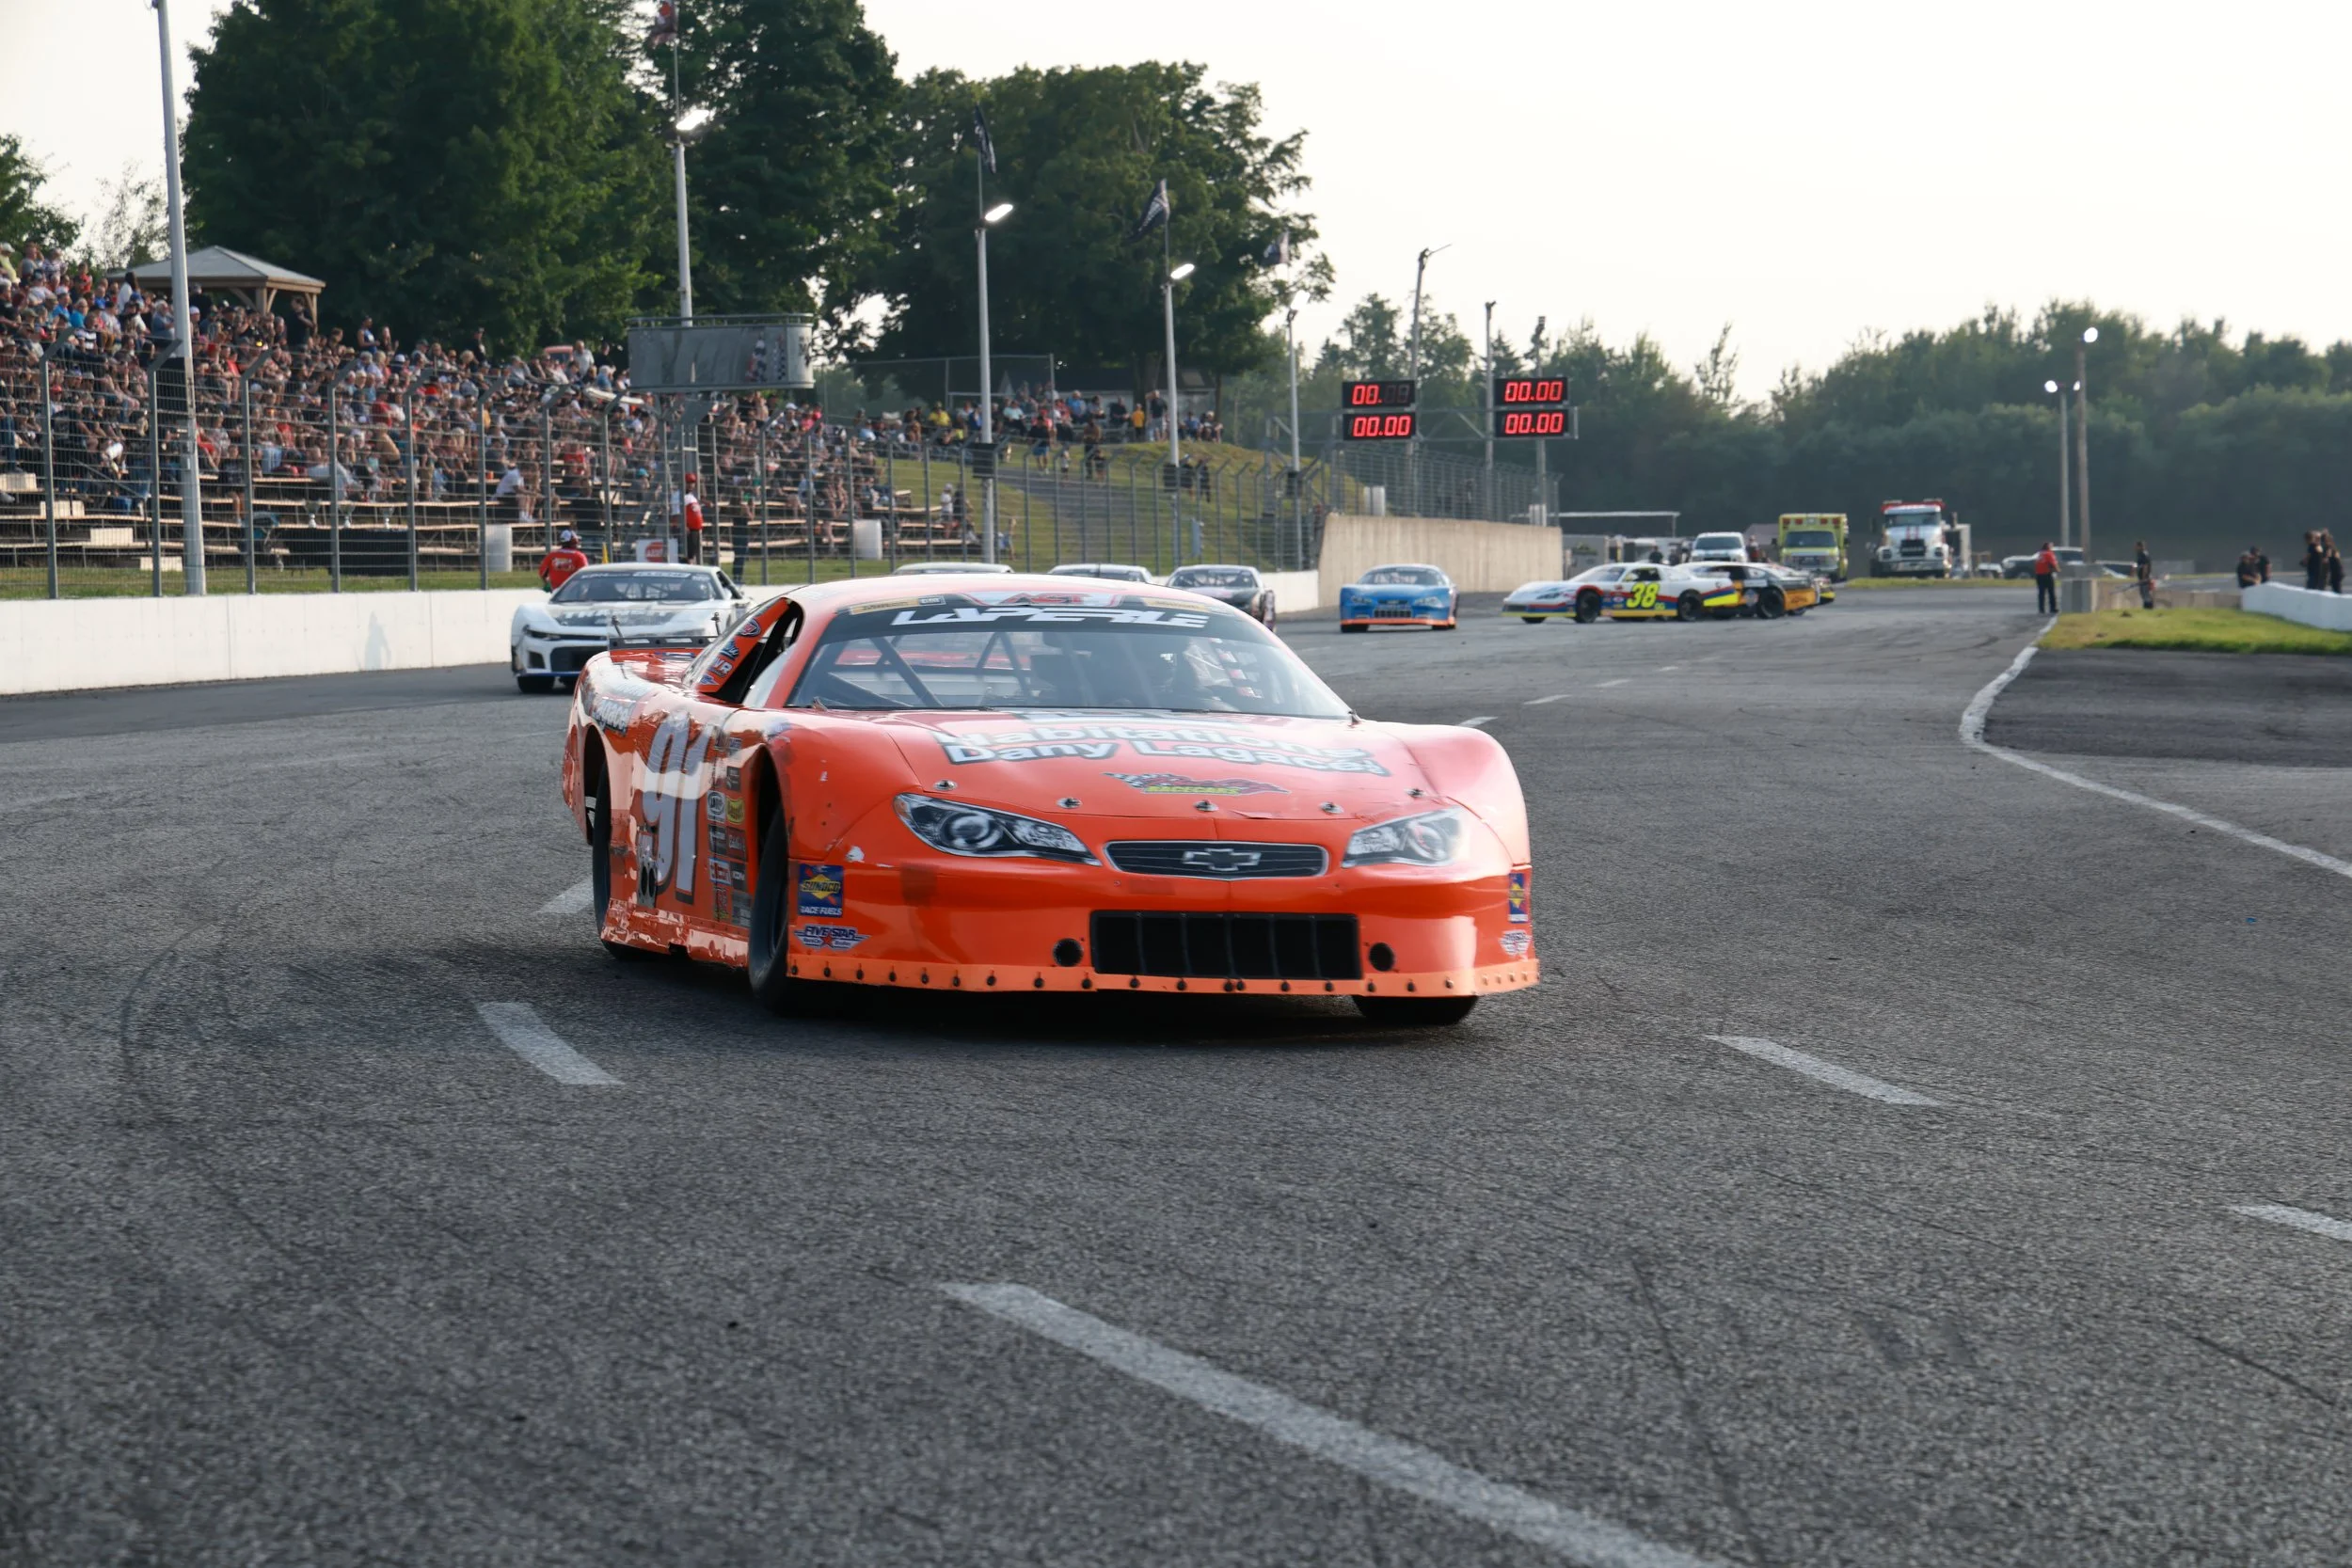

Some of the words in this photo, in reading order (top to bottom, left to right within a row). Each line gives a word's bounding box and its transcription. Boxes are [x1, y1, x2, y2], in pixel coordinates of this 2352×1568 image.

[1504, 380, 1564, 403] 00.00
[1352, 415, 1411, 437] 00.00
[1504, 412, 1564, 435] 00.00
[1626, 581, 1660, 609] 38
[933, 725, 1369, 759] Habitations
[944, 741, 1120, 765] Dany
[642, 709, 712, 895] 91
[803, 879, 841, 894] SUNOCO
[820, 907, 843, 916] FUELS
[805, 926, 829, 937] FIVE
[832, 927, 857, 939] STAR
